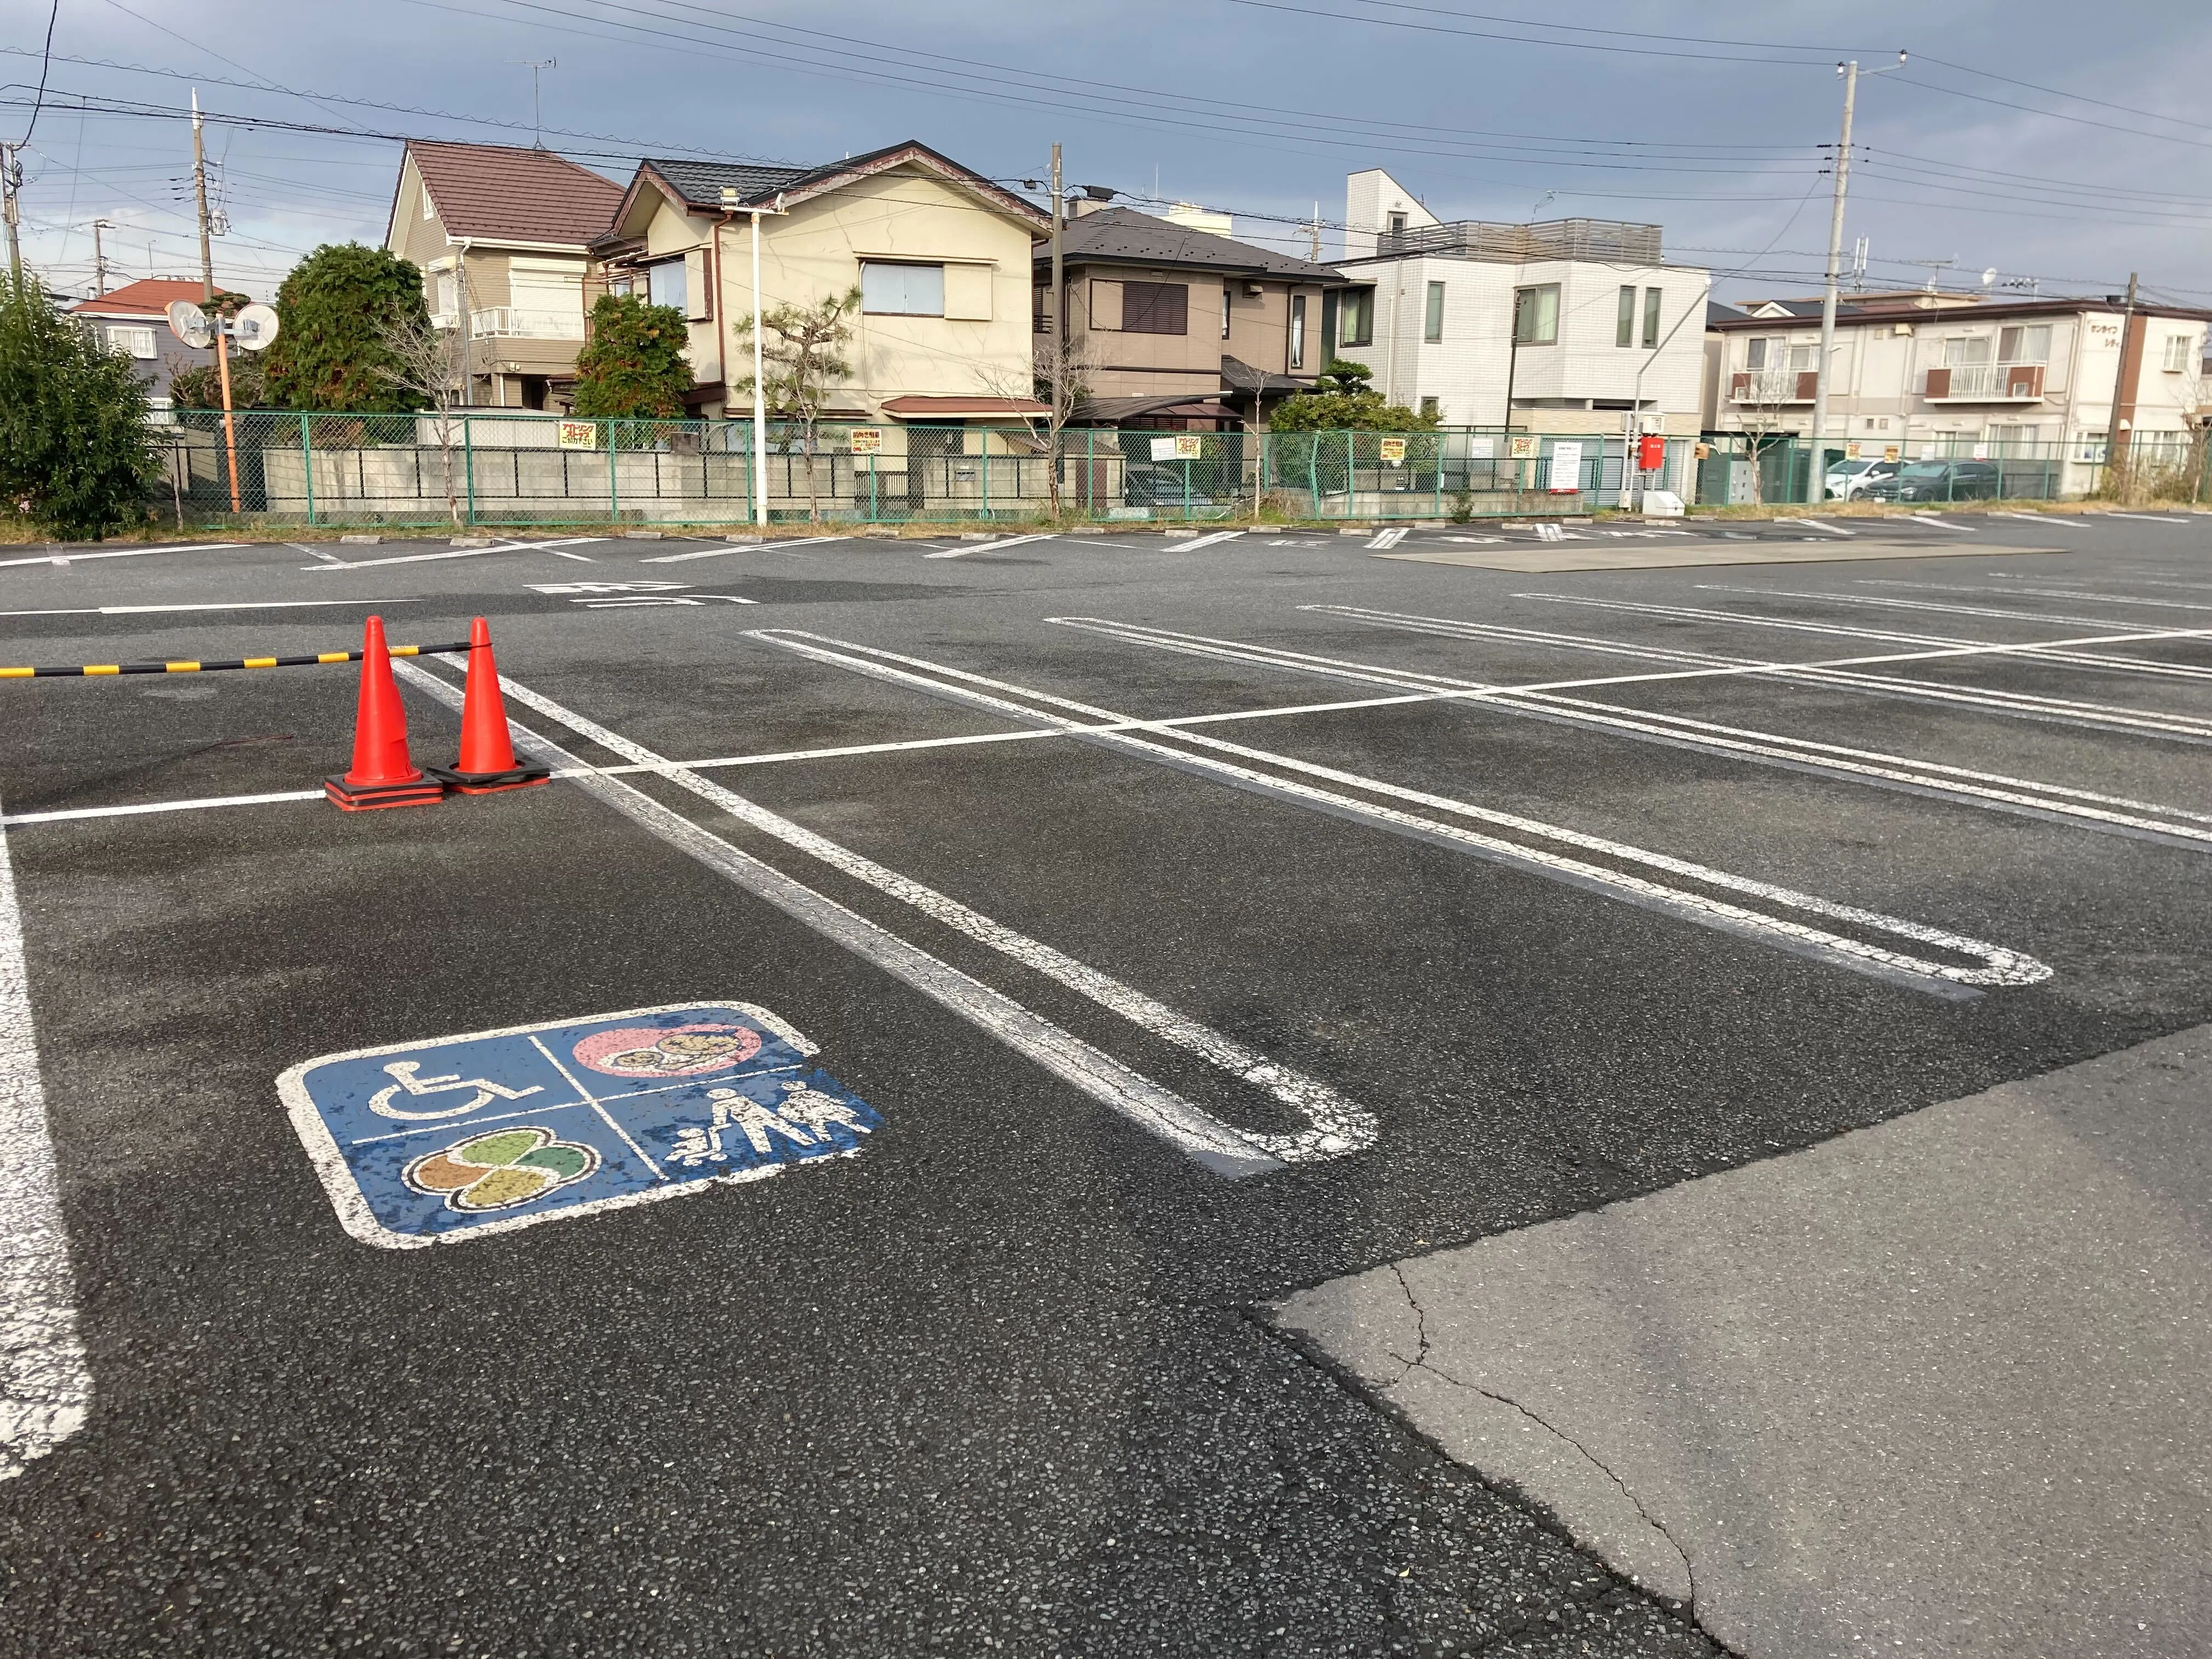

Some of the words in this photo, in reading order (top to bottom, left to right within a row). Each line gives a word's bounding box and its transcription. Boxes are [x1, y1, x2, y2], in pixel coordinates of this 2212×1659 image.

[562, 424, 594, 432] アイドリング
